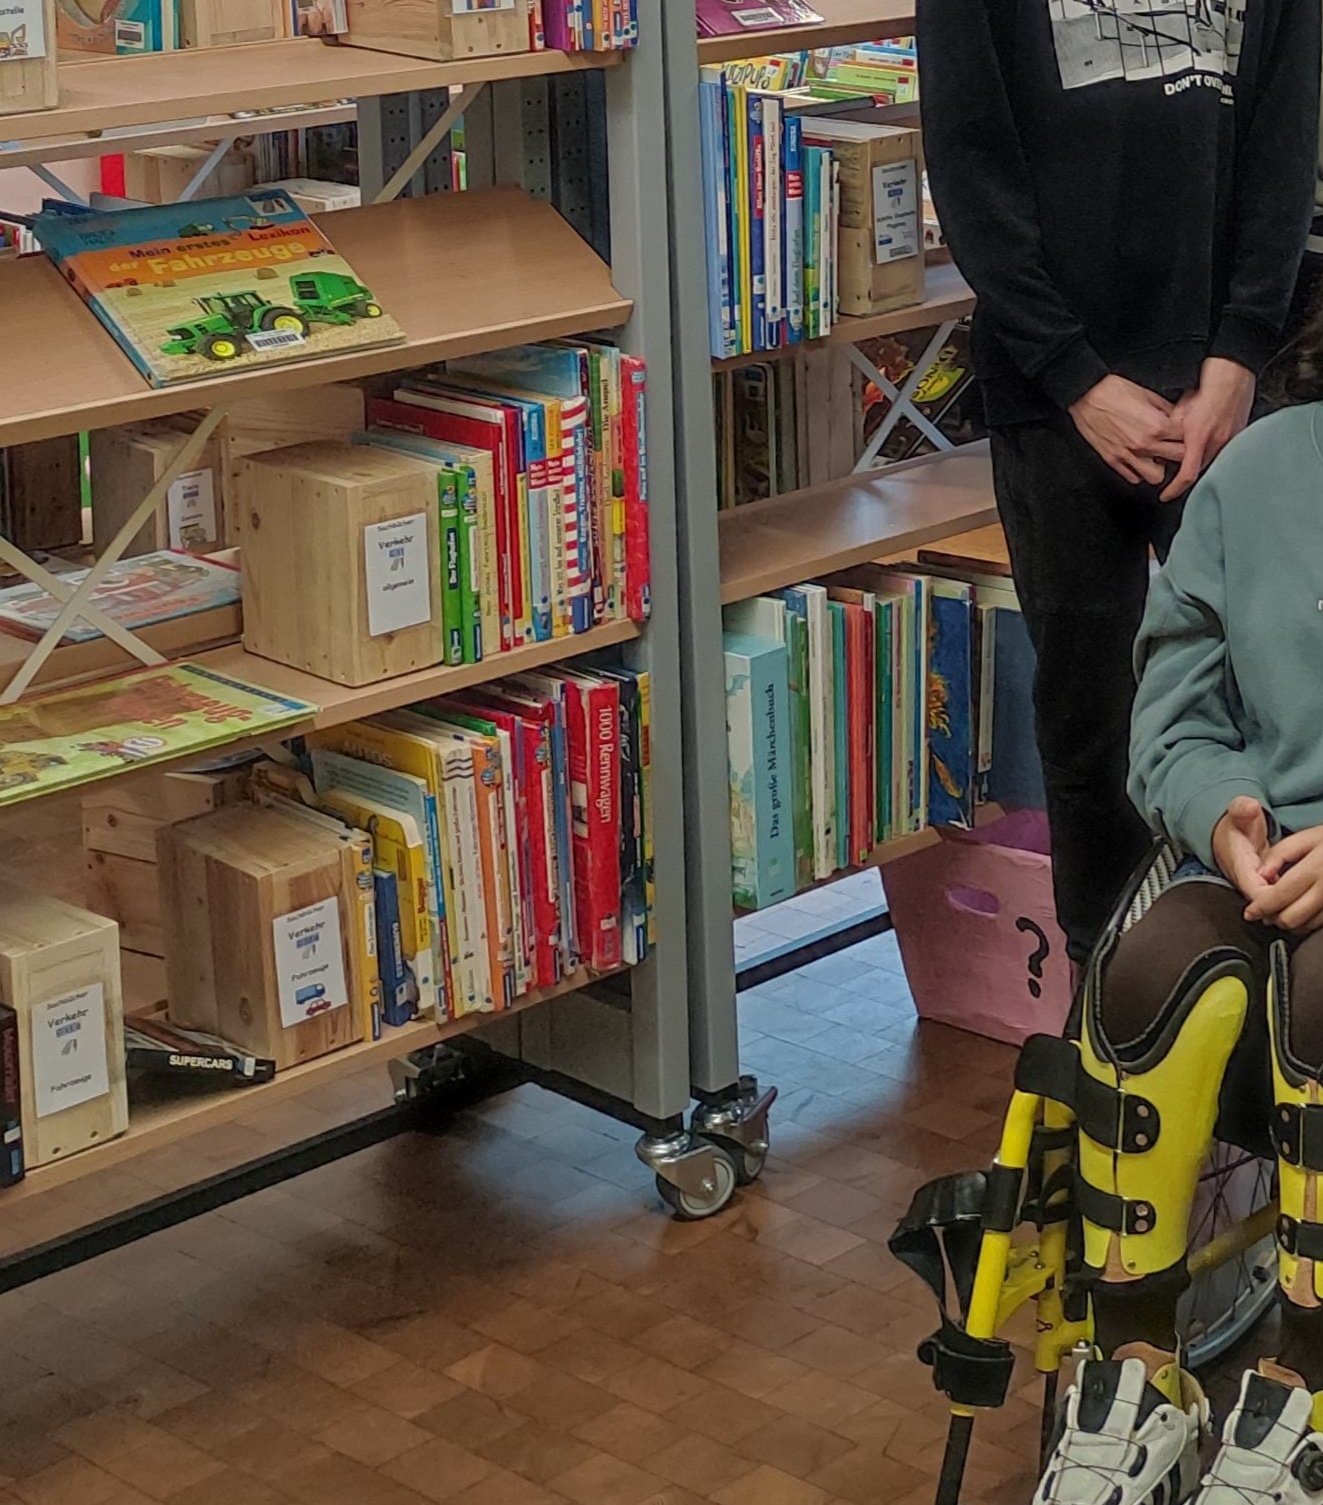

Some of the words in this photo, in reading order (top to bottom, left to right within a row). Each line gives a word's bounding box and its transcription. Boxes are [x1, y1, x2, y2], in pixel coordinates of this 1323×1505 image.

[1164, 75, 1202, 95] DON'T
[108, 259, 139, 273] der
[148, 240, 306, 276] Fahrzeuge
[129, 245, 171, 260] Mein
[176, 239, 231, 253] erstes
[248, 226, 311, 242] Lexikon
[601, 379, 611, 412] Ampel
[378, 535, 415, 550] Verkehr
[447, 531, 458, 569] Flughafen
[599, 706, 613, 740] 1000
[764, 683, 777, 770] Märchenbuch
[595, 743, 614, 823] Rennwagen
[767, 774, 781, 810] große
[769, 813, 780, 838] Das
[287, 921, 326, 940] Verkehr
[47, 1008, 89, 1029] Verkehr
[169, 1054, 233, 1071] SUPERCARS
[50, 1073, 92, 1093] Fahrzeuge
